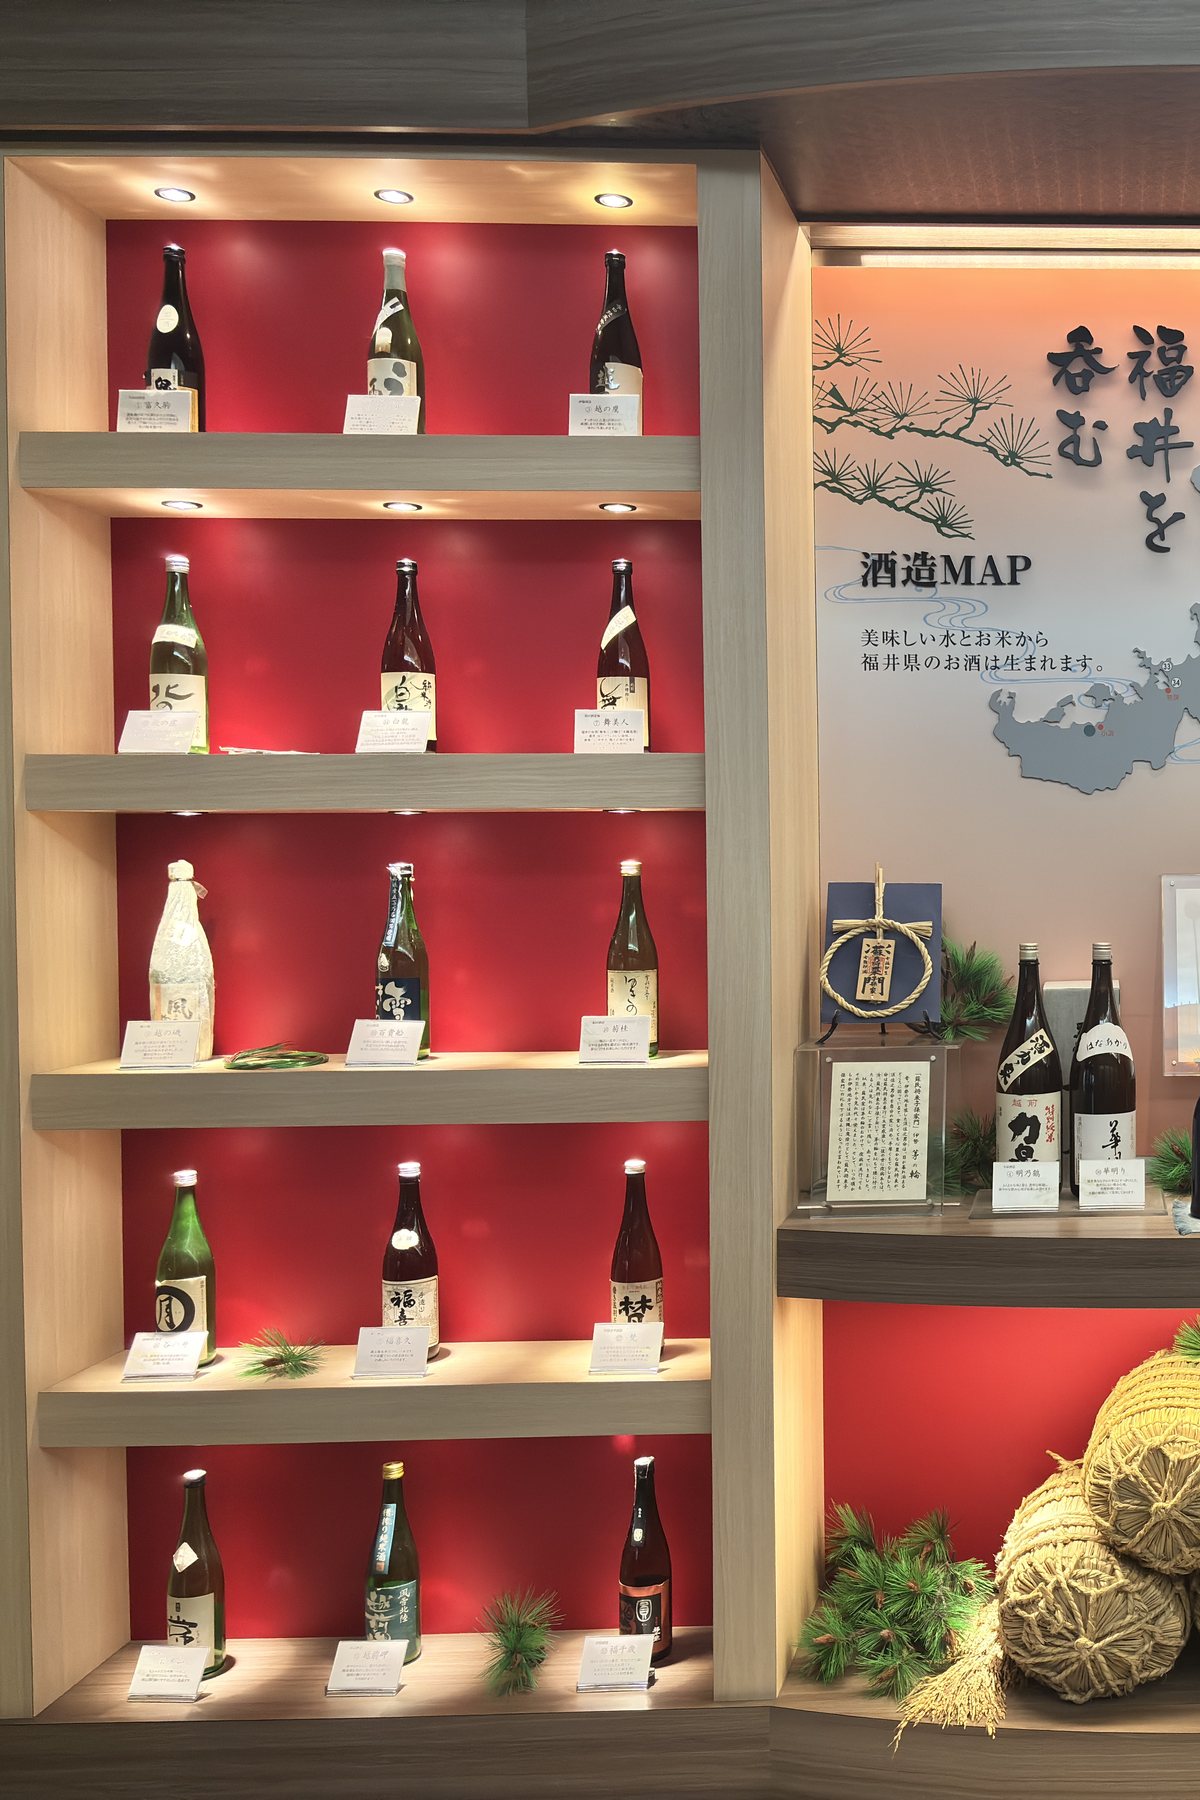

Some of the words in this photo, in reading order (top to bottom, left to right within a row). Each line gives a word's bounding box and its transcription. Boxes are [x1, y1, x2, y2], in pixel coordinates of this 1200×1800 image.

[1047, 325, 1119, 467] 呑む
[1126, 325, 1194, 553] 福井を
[860, 551, 1032, 588] 酒造MAP
[861, 629, 1049, 648] 美味しい水とお米から
[861, 653, 1103, 672] 福井県のお酒は生まれます。
